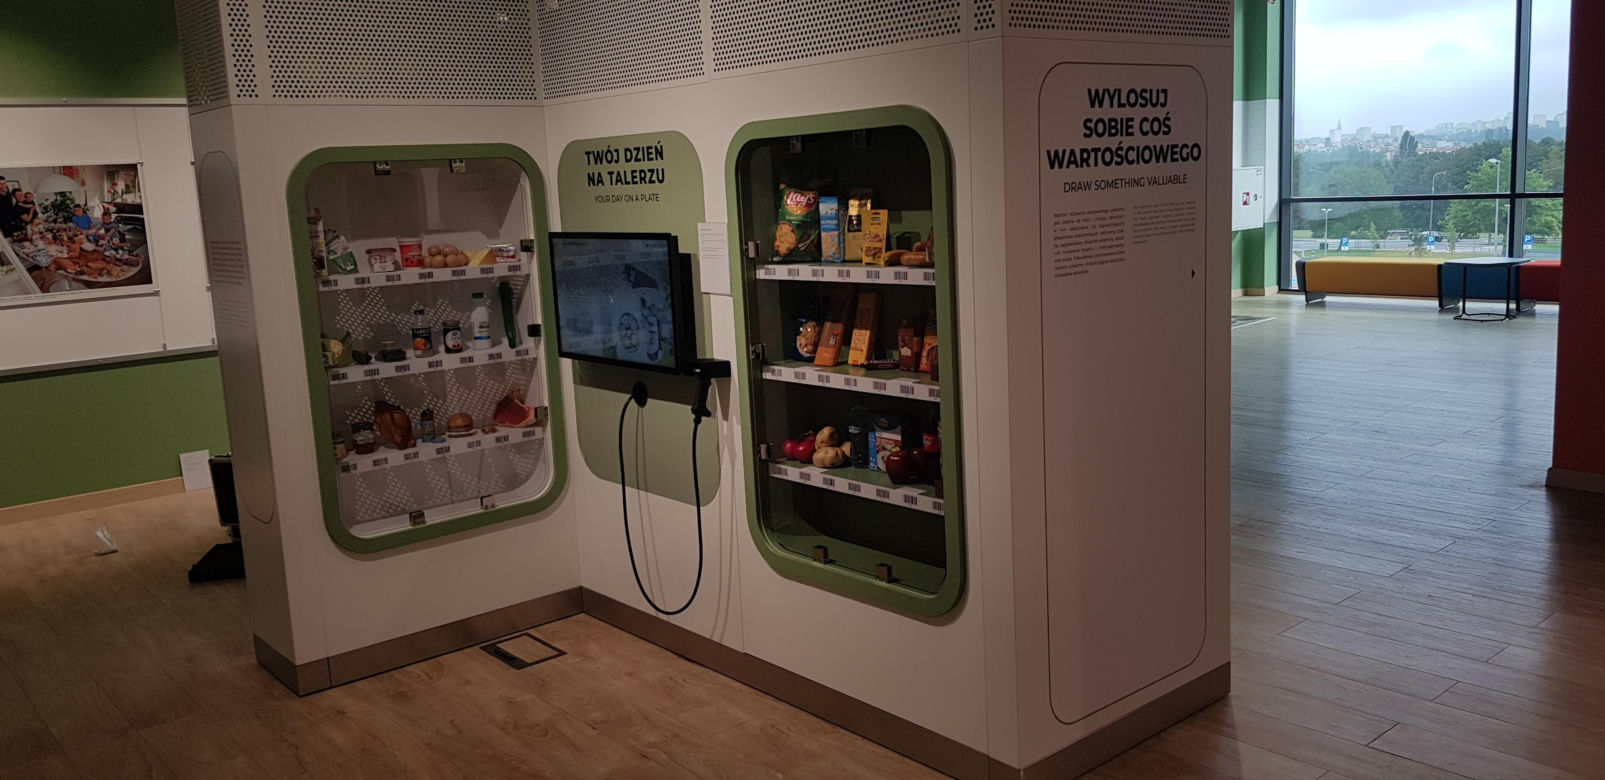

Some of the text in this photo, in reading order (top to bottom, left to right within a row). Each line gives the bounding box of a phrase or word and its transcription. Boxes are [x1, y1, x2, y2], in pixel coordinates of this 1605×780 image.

[1087, 87, 1168, 109] WYLOSUJ
[1082, 111, 1172, 139] SOBIE COŚ
[585, 140, 664, 166] TWÓJ DZIEŃ
[1046, 141, 1202, 170] WARTOŚCIOWEGO
[587, 167, 665, 187] NA TALERZU
[1063, 173, 1188, 193] DRAW SOMETHING VALUABLE
[594, 194, 611, 204] YOUR
[611, 194, 624, 204] DAY
[625, 193, 634, 203] ON
[640, 192, 660, 202] PLATE
